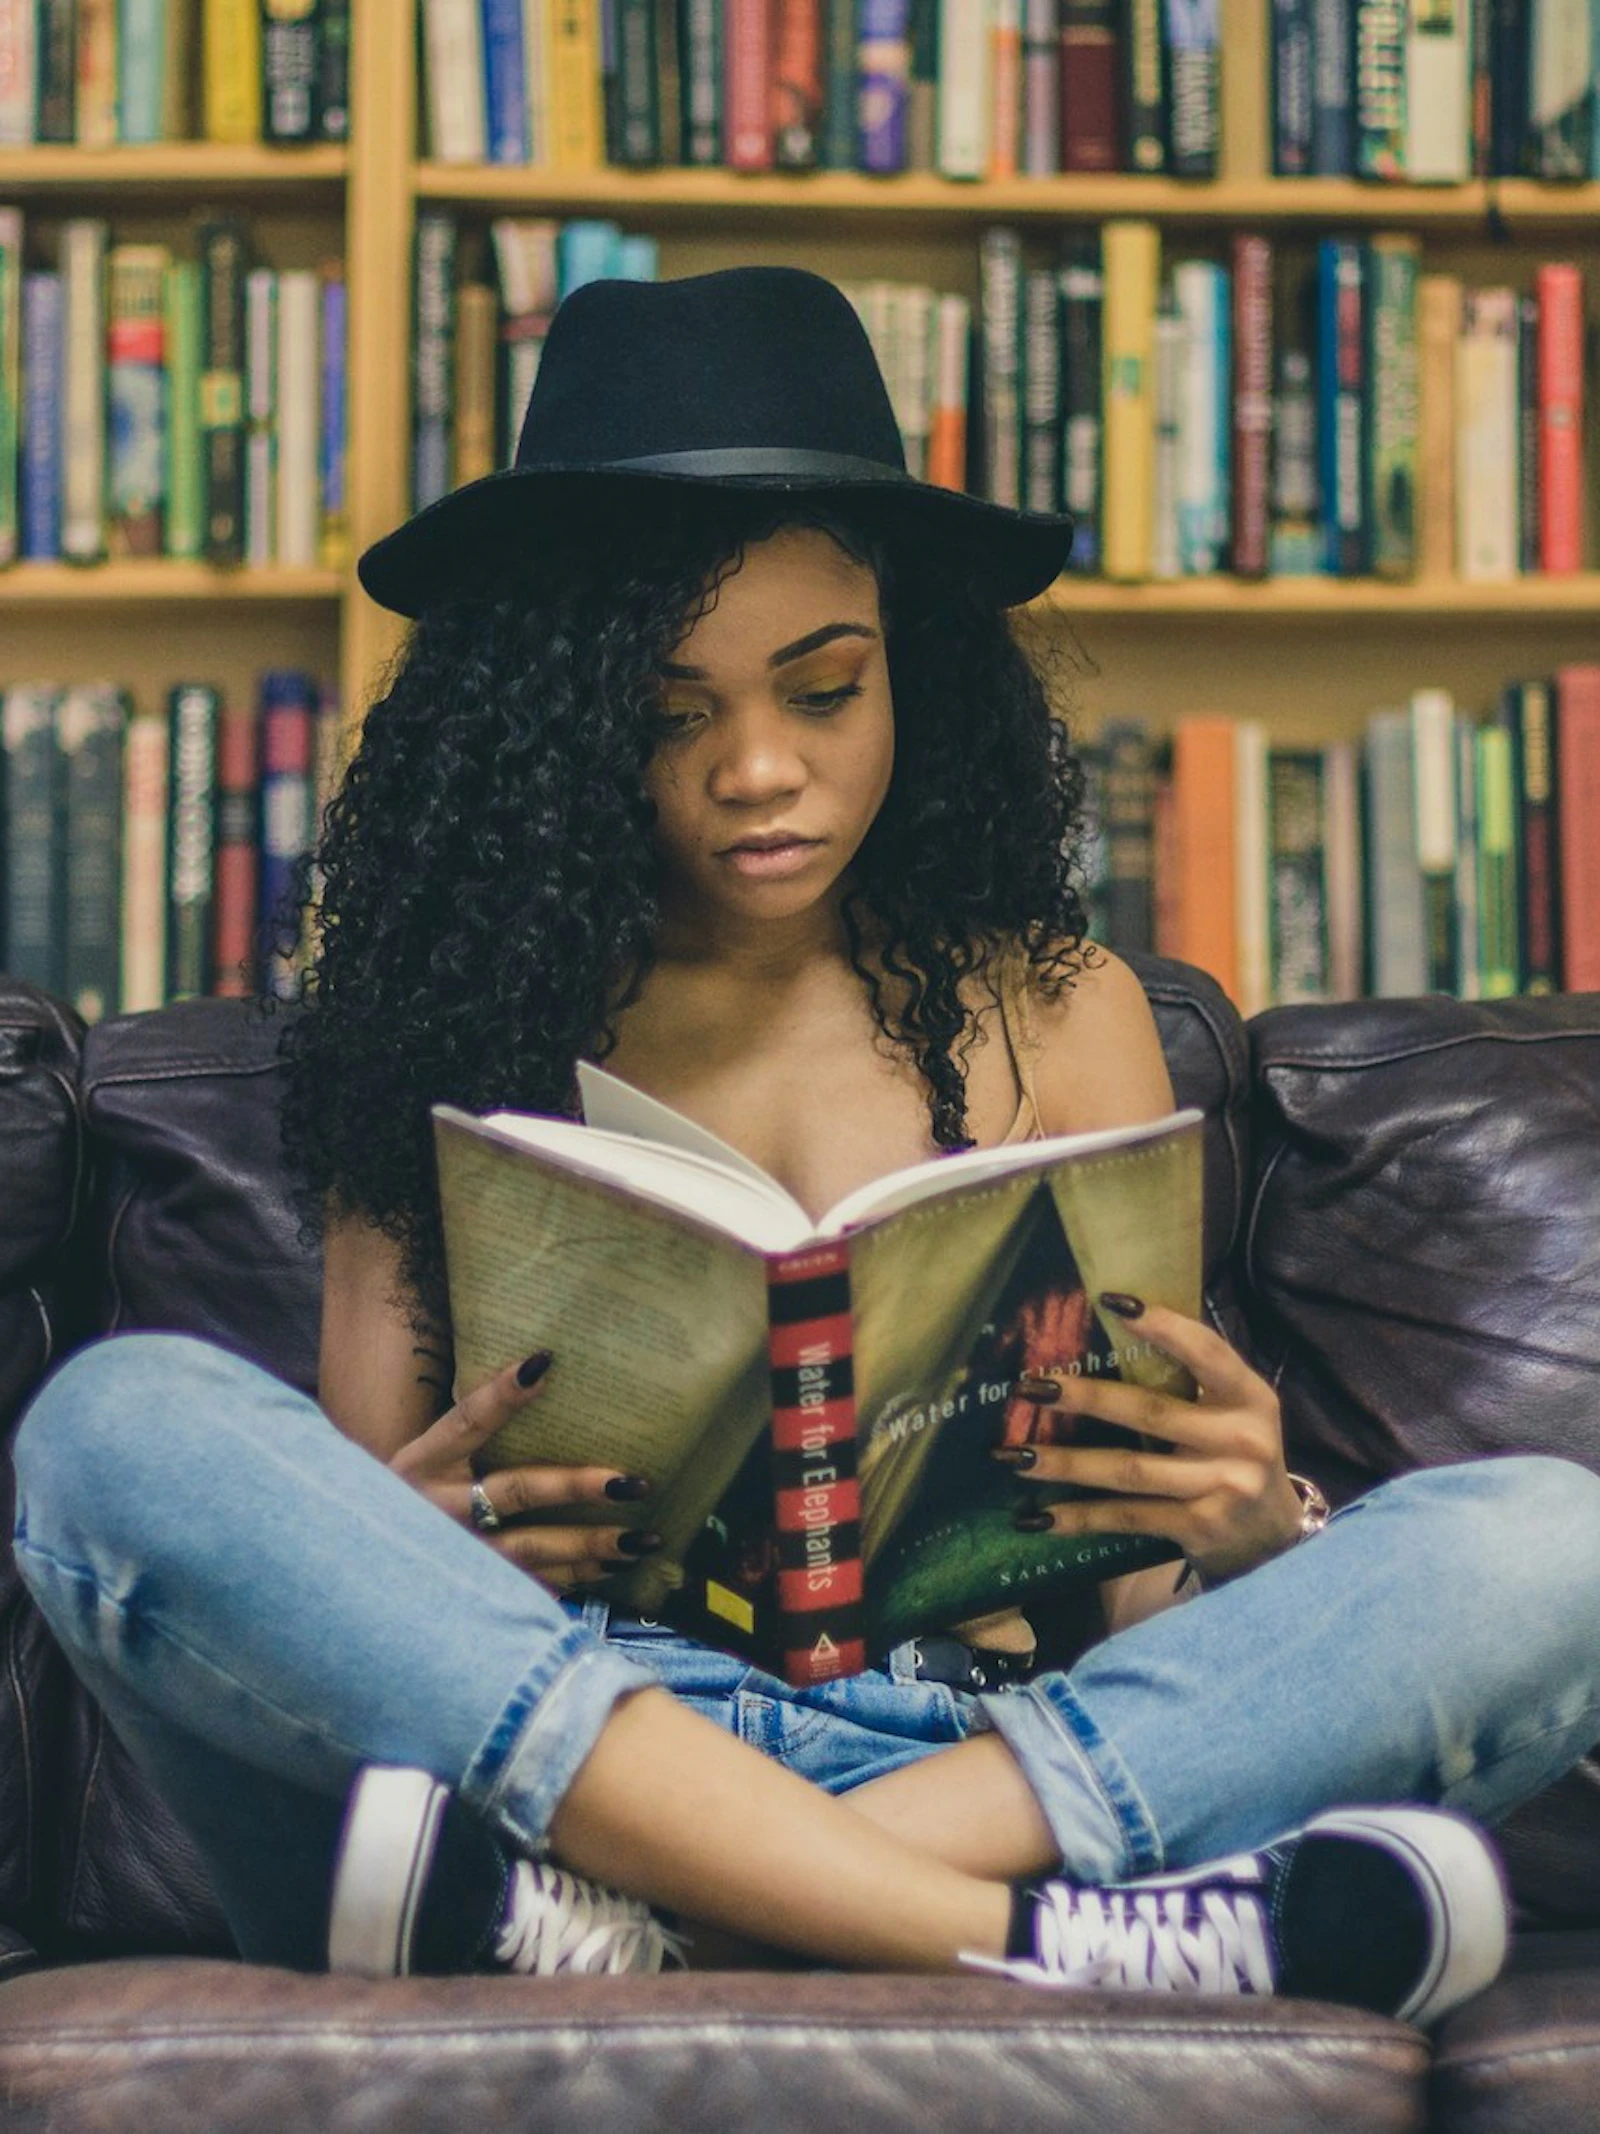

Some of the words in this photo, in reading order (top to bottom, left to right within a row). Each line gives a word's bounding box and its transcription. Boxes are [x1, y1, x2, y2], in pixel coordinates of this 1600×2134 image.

[797, 1341, 833, 1416] Water
[887, 1392, 969, 1443] Water
[977, 1380, 1010, 1406] for
[1018, 1340, 1156, 1383] Elephant
[801, 1425, 836, 1461] for
[797, 1466, 839, 1592] Elephants
[999, 1559, 1066, 1587] SARA
[1075, 1536, 1147, 1564] GRUE
